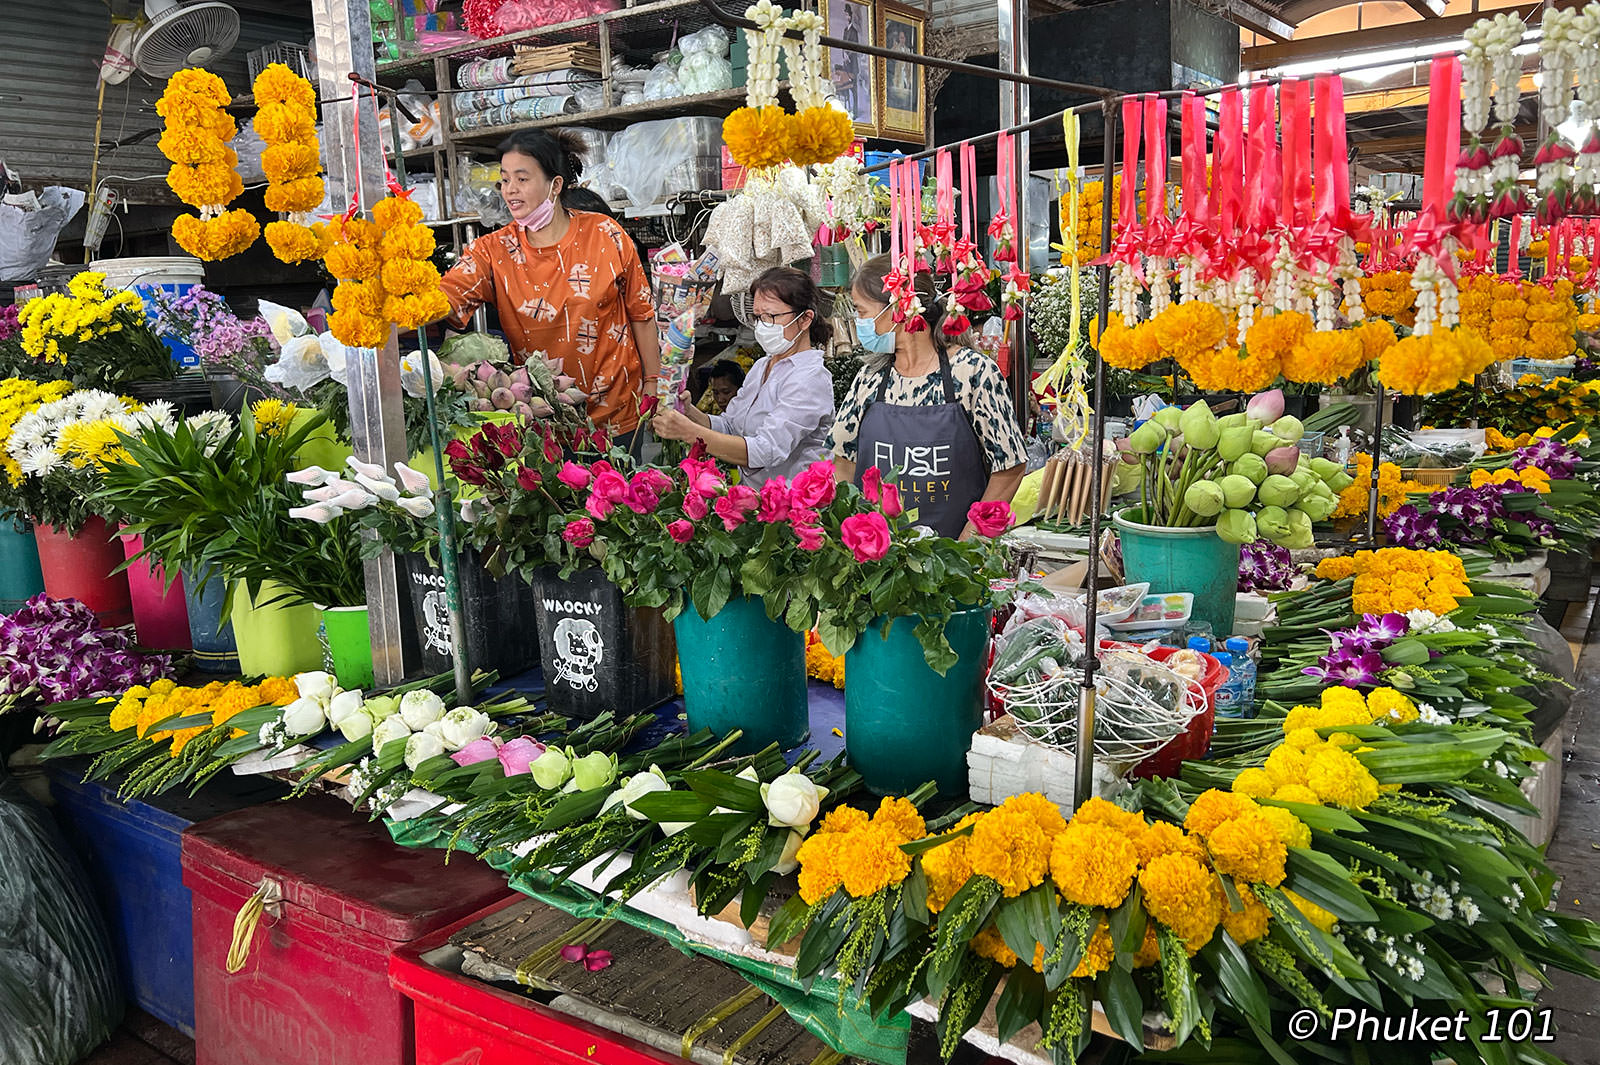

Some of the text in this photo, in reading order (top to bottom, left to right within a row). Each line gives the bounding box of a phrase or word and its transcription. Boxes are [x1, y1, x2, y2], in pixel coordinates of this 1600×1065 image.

[875, 441, 950, 476] FUSE
[900, 480, 950, 492] LLEY
[542, 598, 603, 615] WAOCKY
